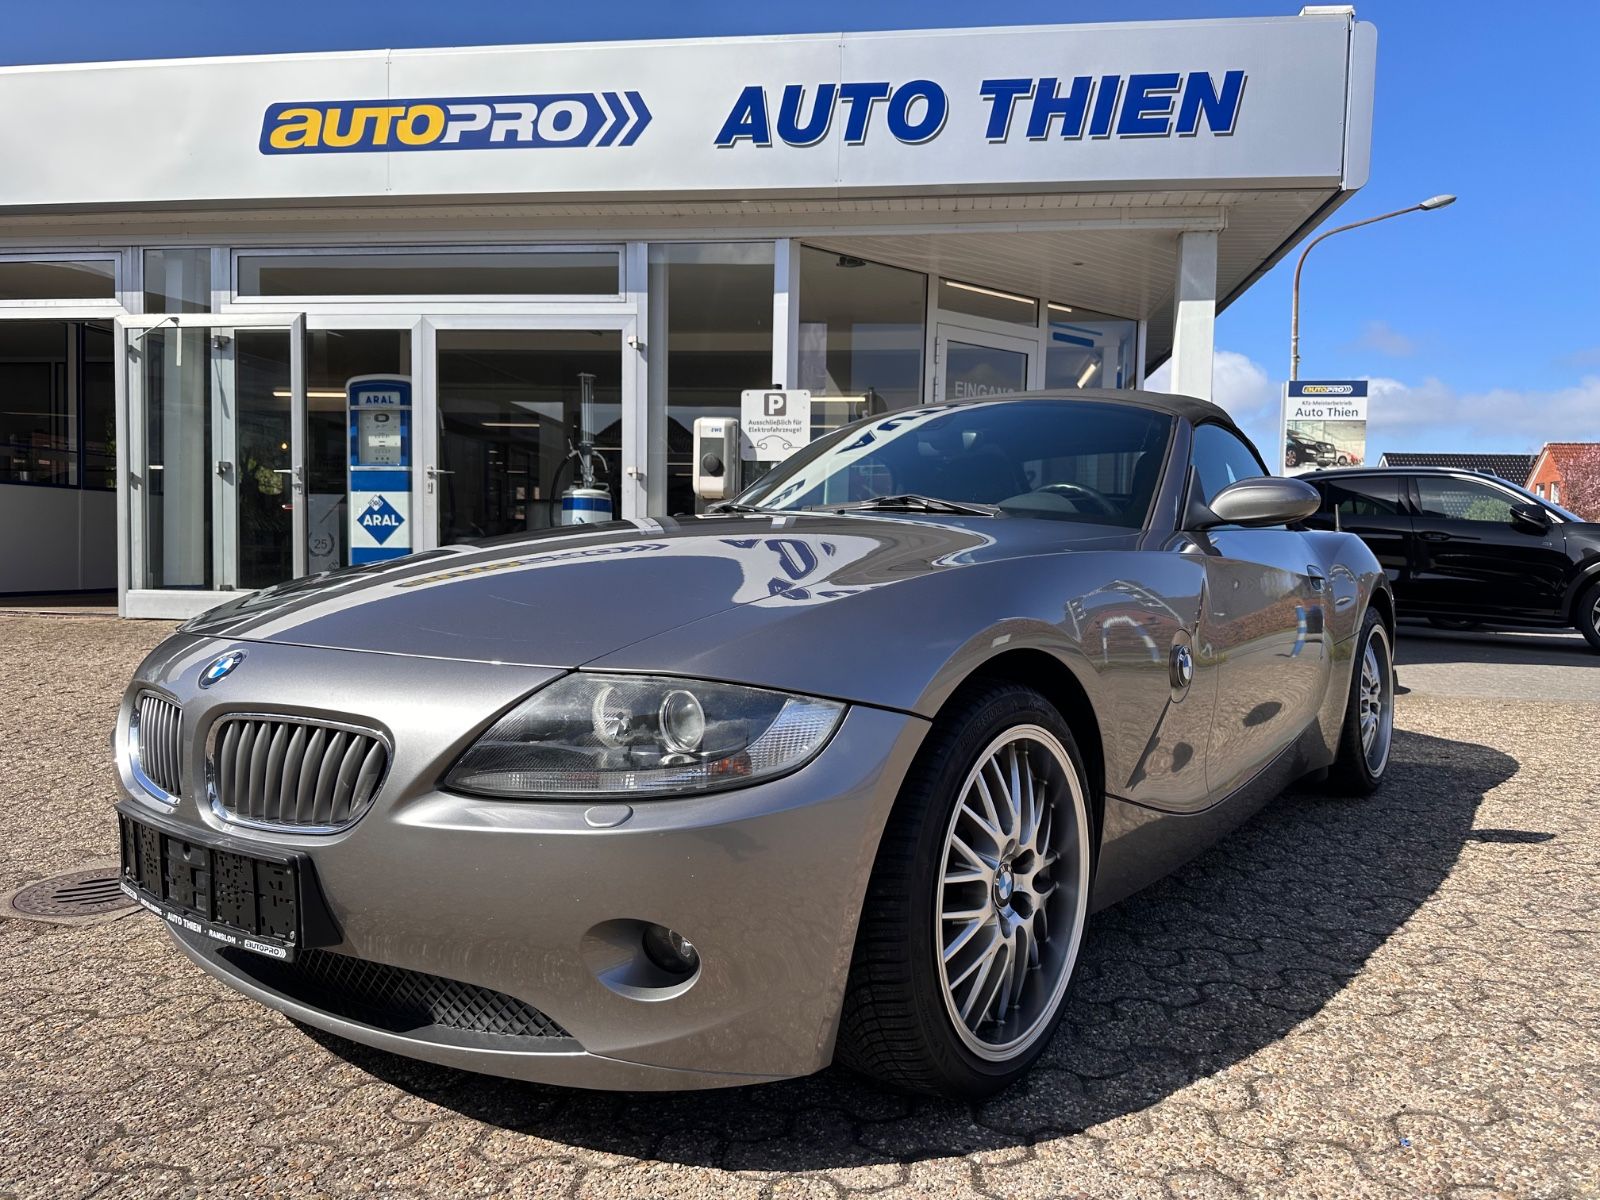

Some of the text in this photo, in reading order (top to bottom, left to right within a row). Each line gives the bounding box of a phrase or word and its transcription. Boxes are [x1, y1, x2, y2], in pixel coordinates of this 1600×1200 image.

[713, 70, 1248, 147] AUTO THIEN
[955, 381, 1015, 398] EINGA
[365, 395, 394, 404] ARAL
[768, 395, 784, 415] P
[1295, 407, 1359, 417] Auto Thien
[363, 514, 399, 526] ARAL
[314, 539, 328, 549] 25
[182, 918, 202, 933] THIEN
